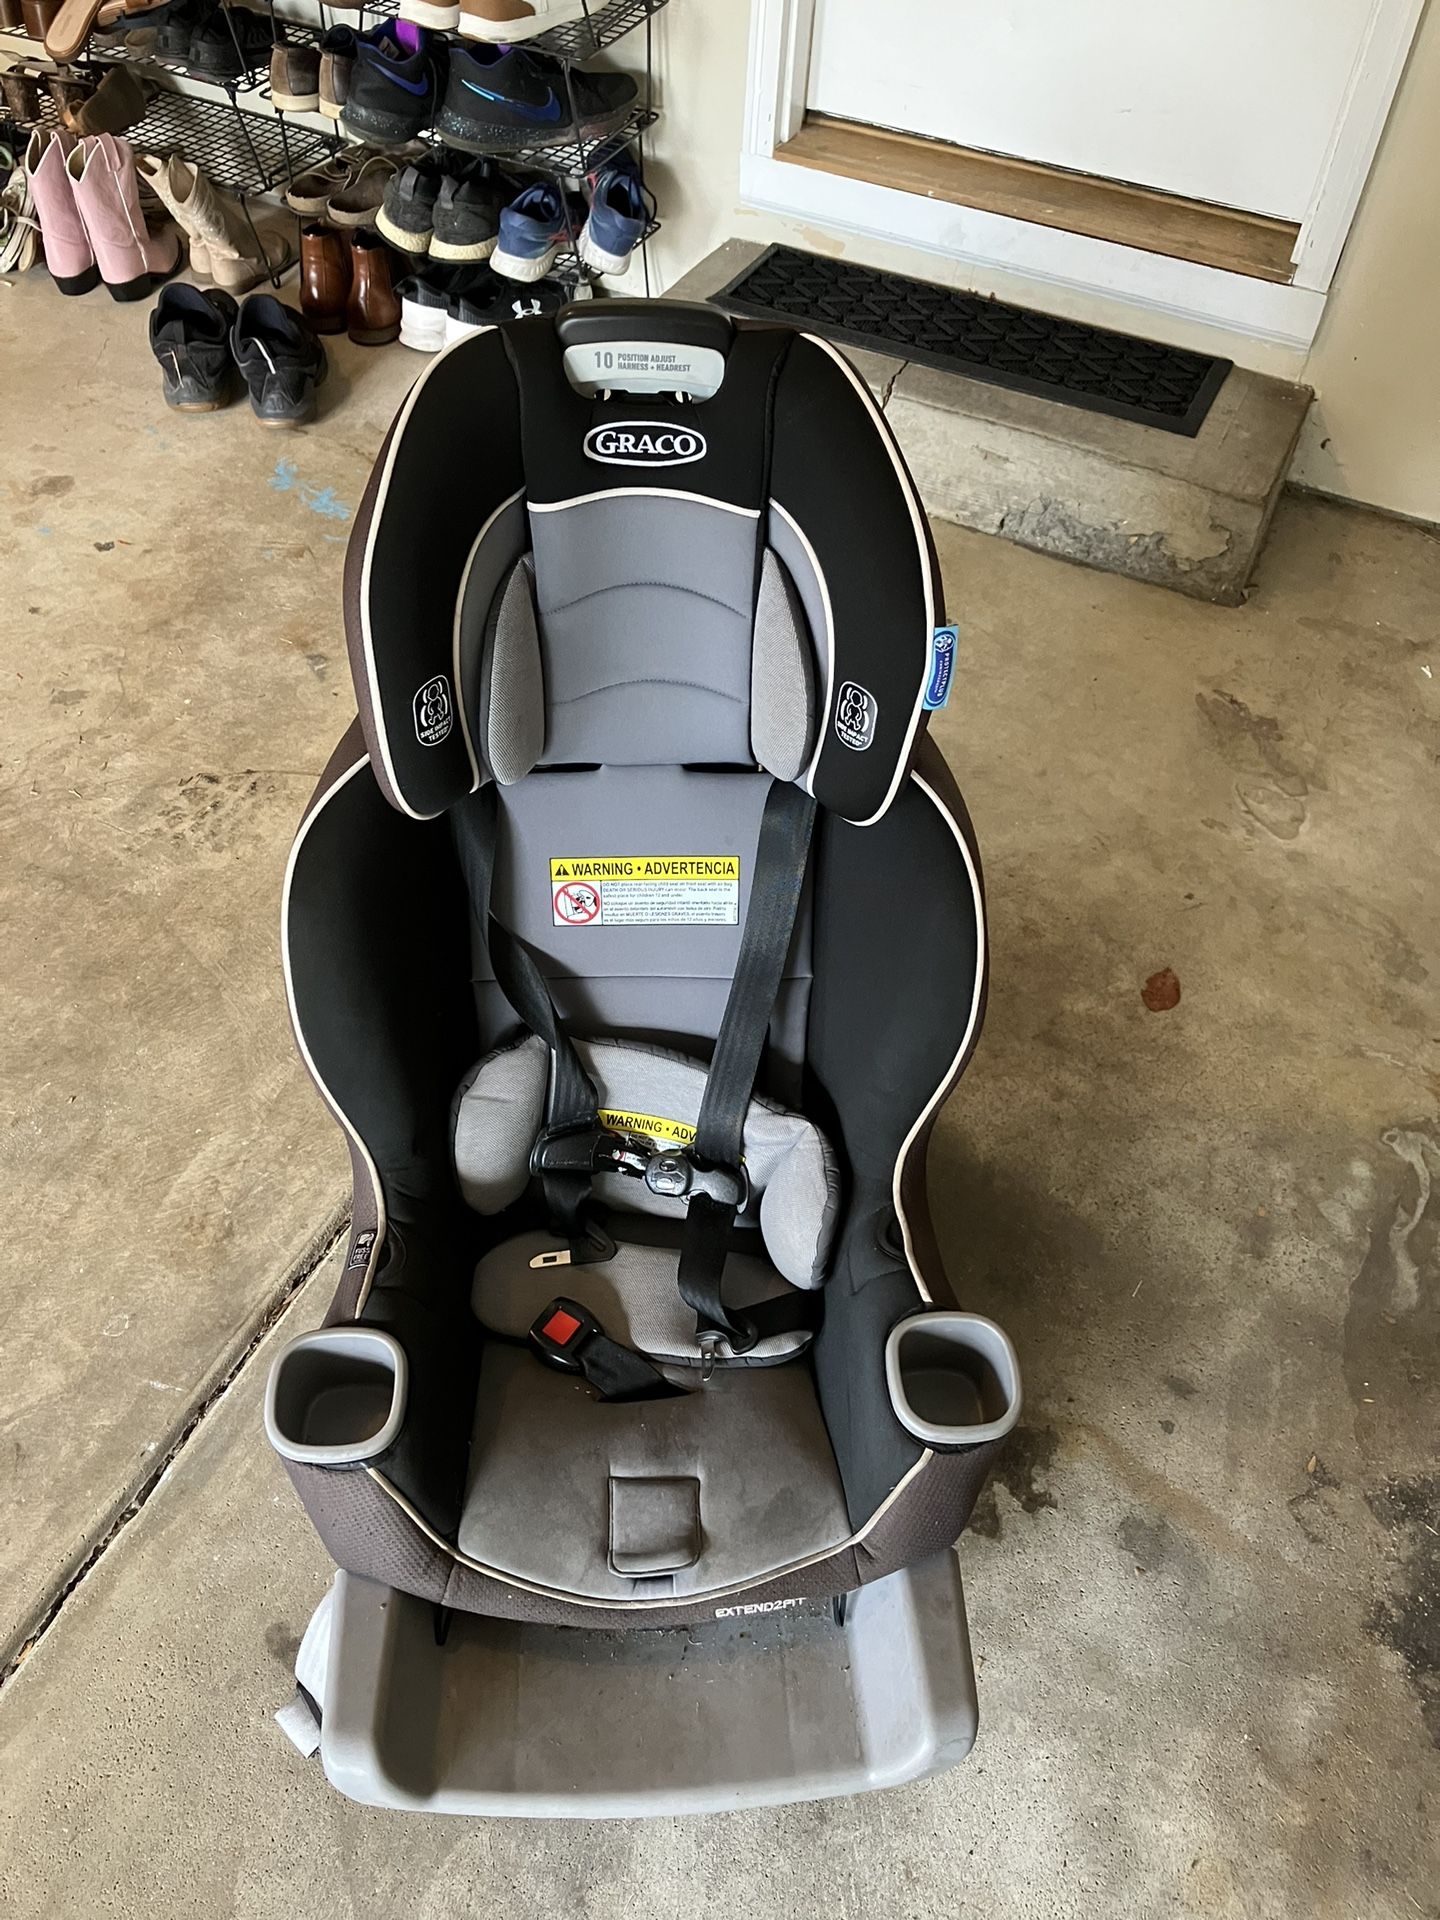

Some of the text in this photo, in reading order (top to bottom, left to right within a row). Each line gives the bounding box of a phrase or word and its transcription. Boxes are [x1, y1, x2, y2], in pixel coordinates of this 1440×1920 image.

[594, 351, 613, 369] 10
[617, 353, 676, 363] POSITION ADJUST
[617, 362, 649, 371] HARNESS
[656, 363, 691, 372] HEADREST
[595, 431, 697, 456] GRACO
[572, 861, 735, 876] WARNING ADVERTENCIA
[606, 1114, 662, 1132] WARNING
[715, 1597, 807, 1618] EXTEND2FIT
